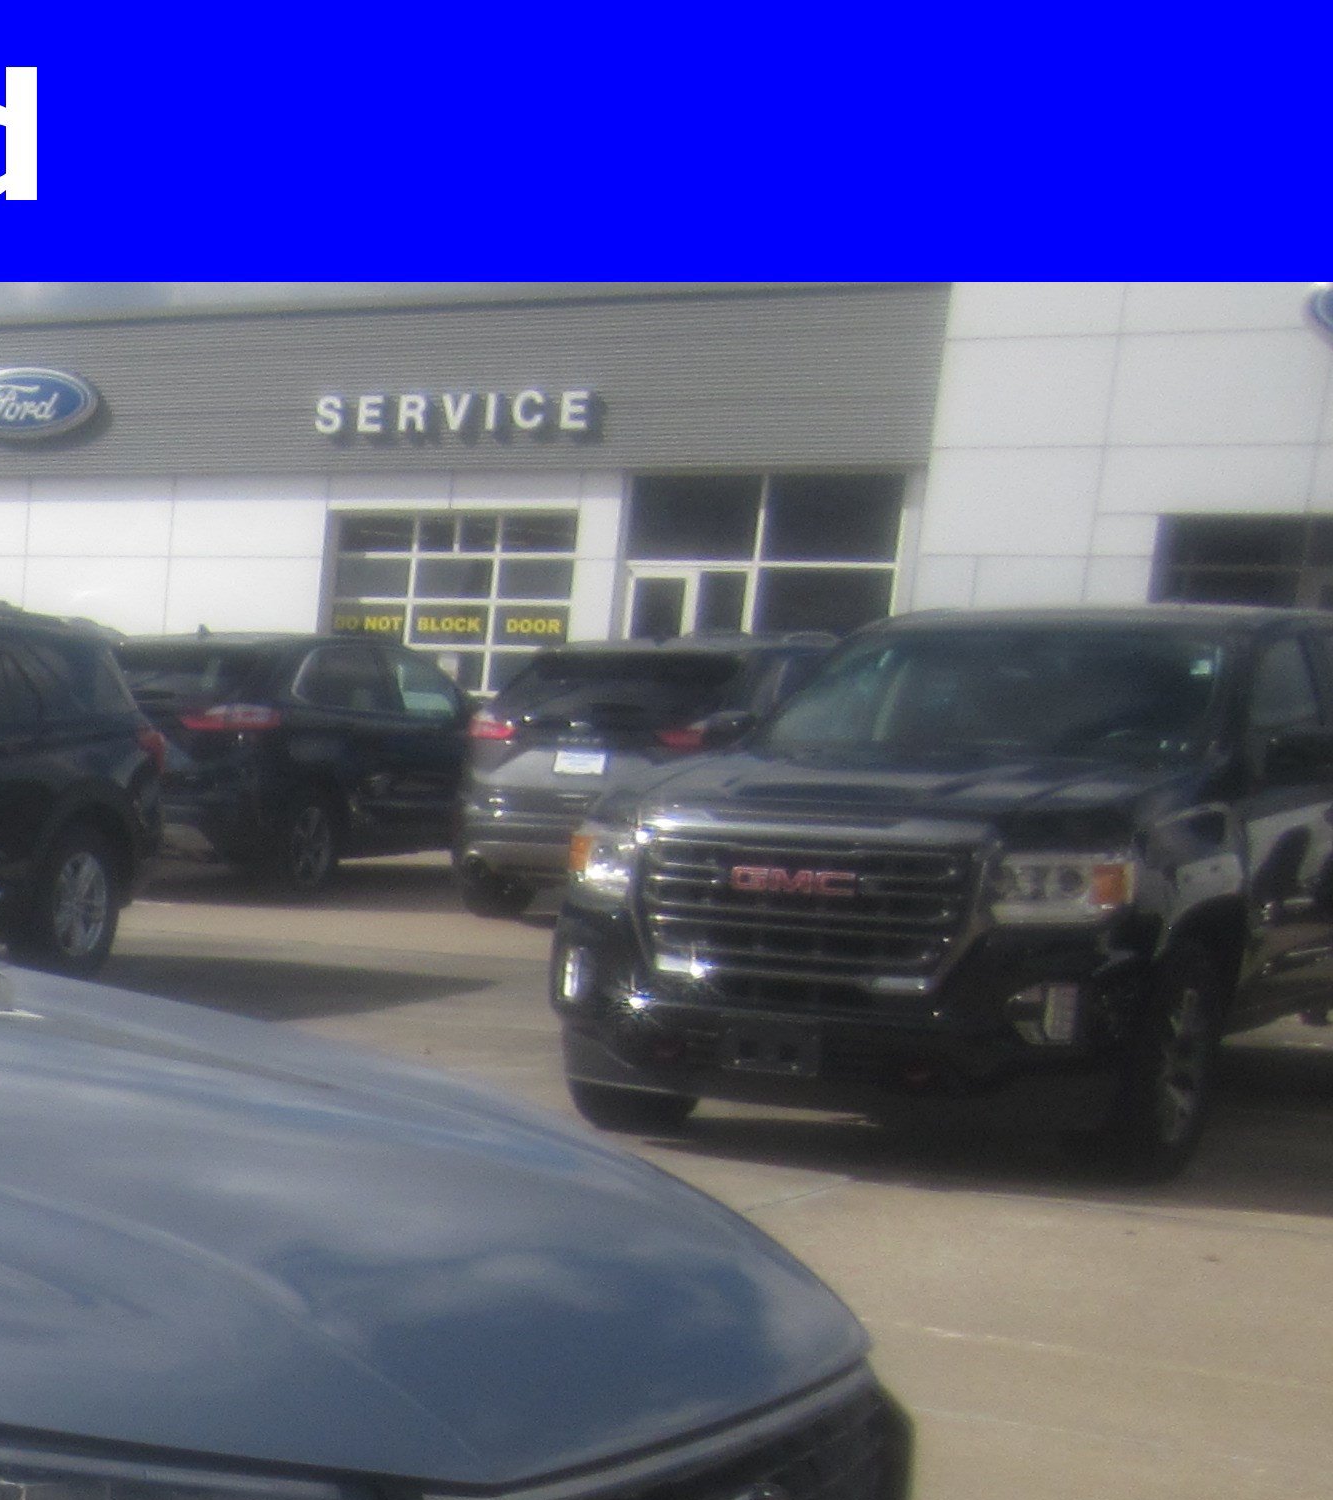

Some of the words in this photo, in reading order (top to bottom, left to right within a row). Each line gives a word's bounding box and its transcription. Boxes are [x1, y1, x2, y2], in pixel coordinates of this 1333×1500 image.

[314, 390, 590, 433] SERVICE
[364, 615, 403, 631] NOT
[417, 616, 481, 632] BLOCK
[506, 617, 561, 634] DOOR
[732, 866, 856, 896] GMC
